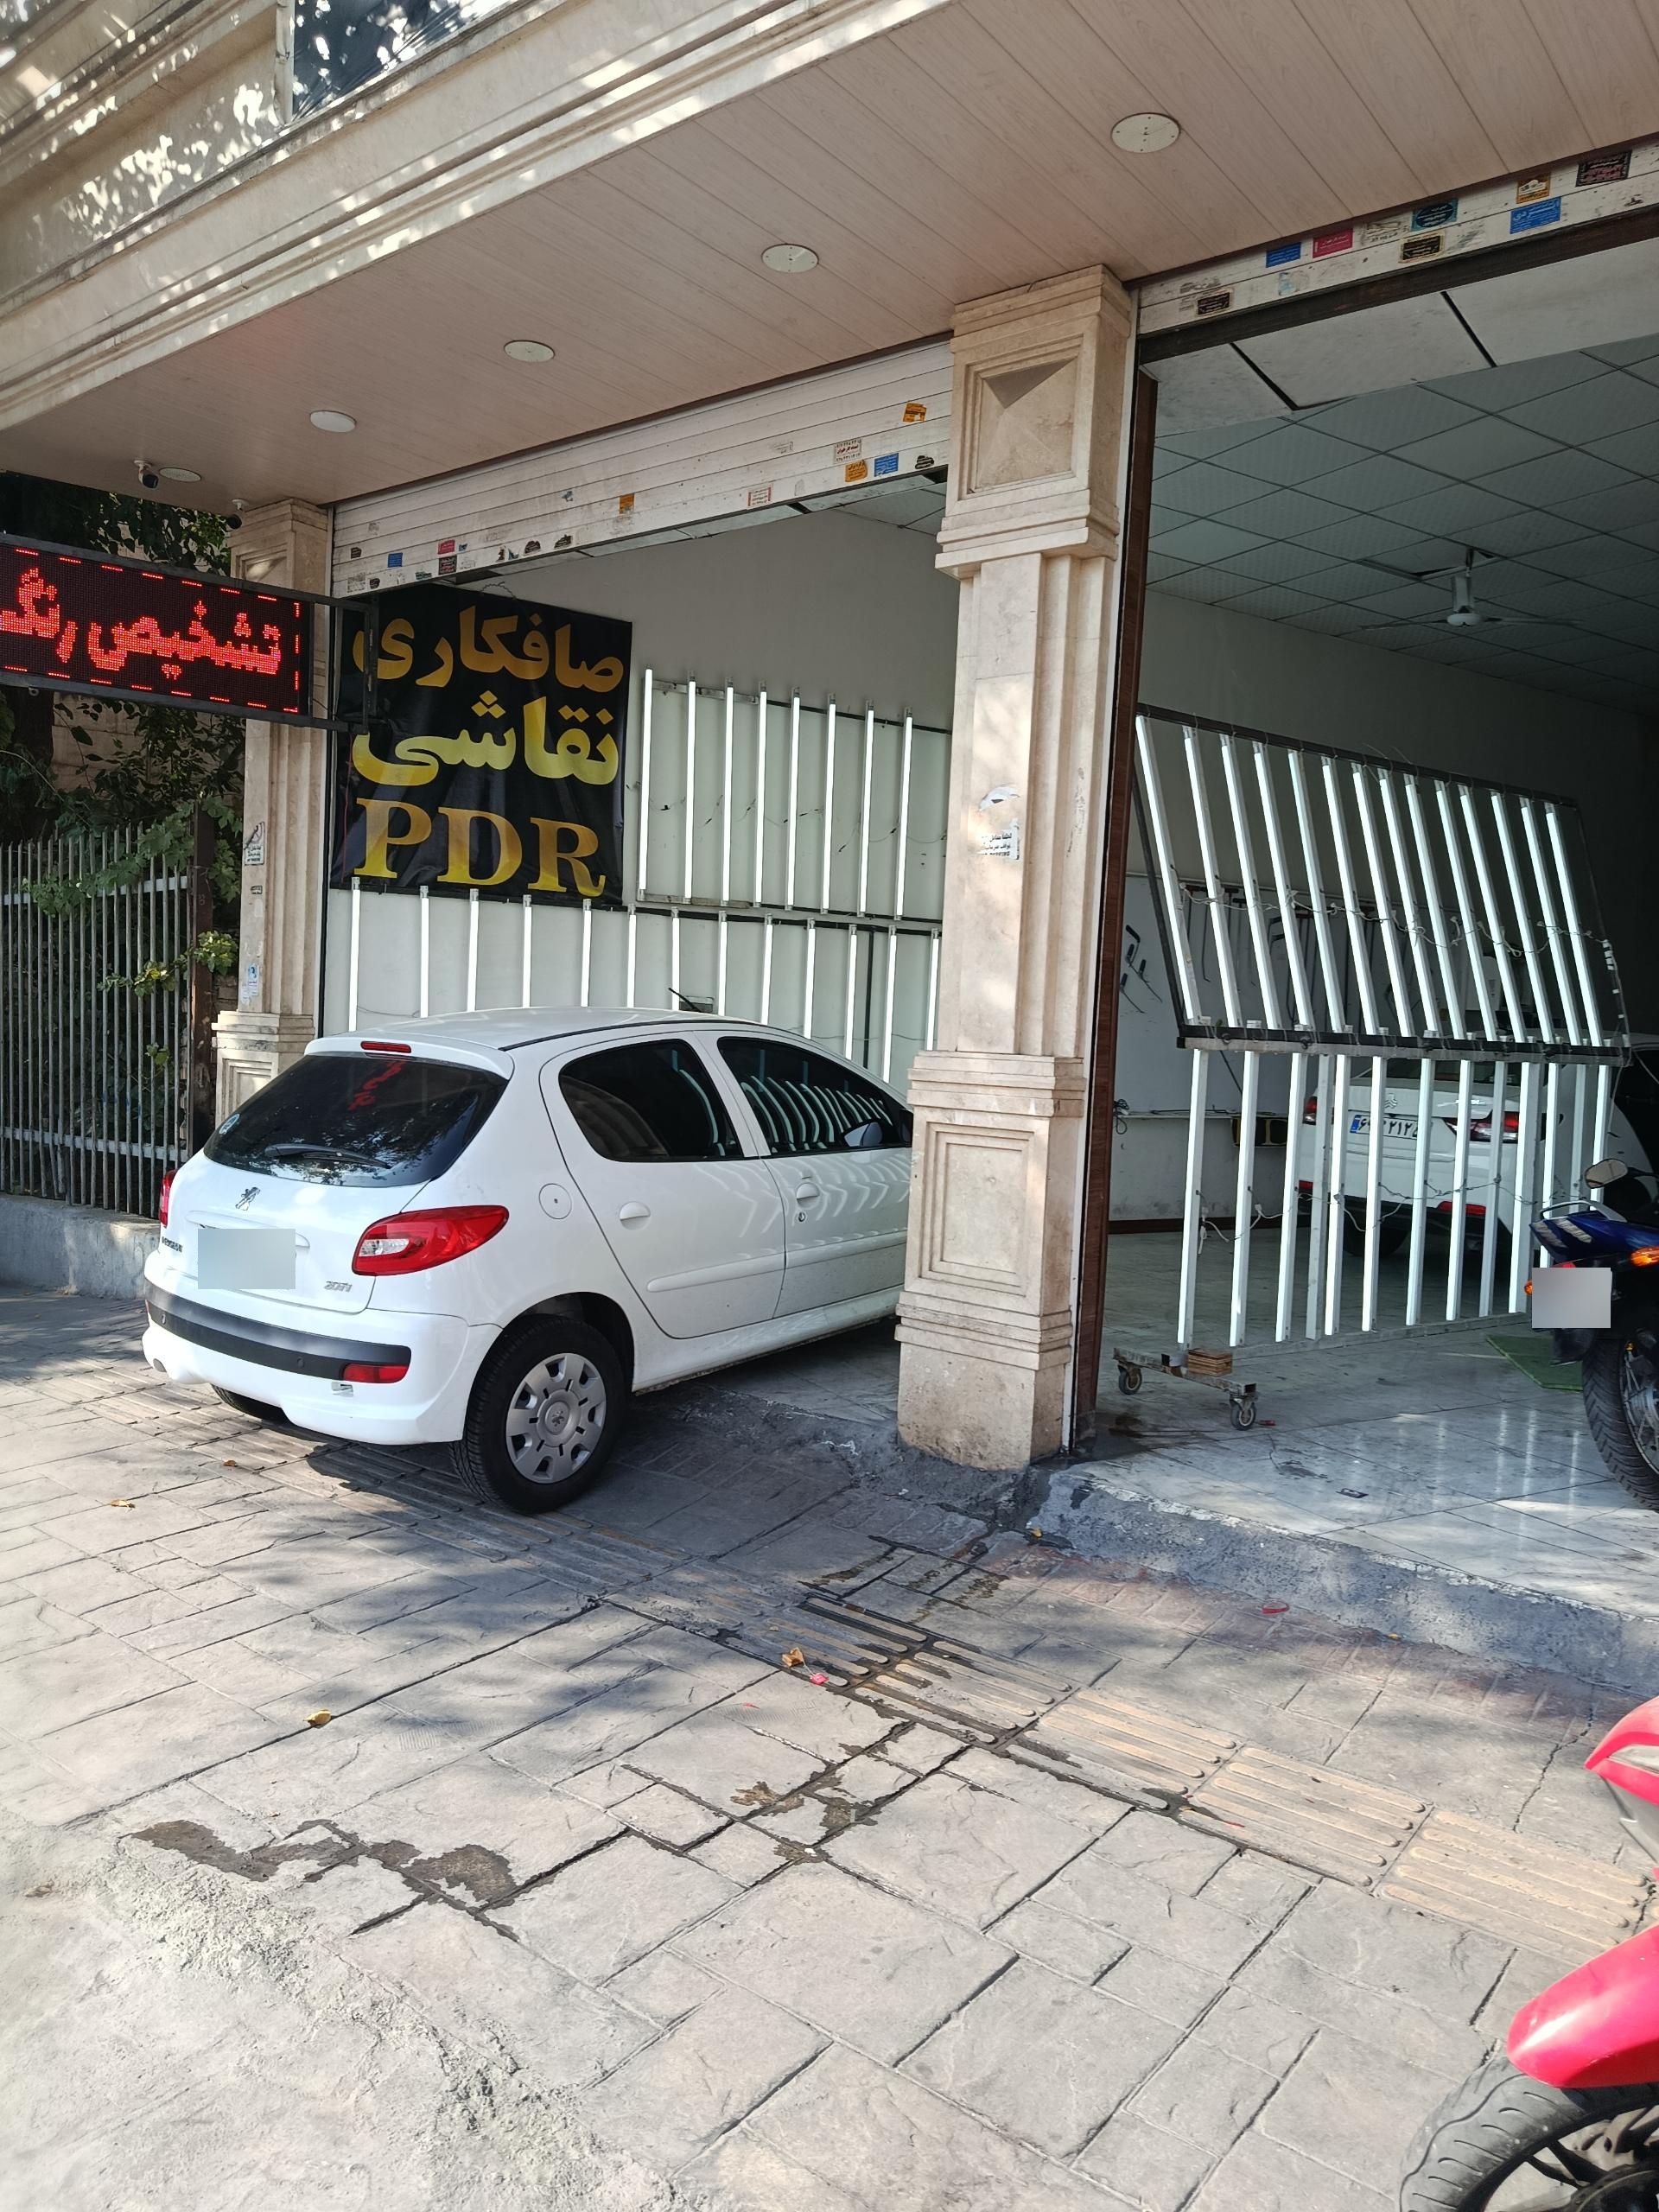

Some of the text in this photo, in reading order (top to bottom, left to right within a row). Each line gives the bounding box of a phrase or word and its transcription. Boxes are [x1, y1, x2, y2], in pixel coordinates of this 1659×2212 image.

[87, 599, 282, 680] تشخیص
[353, 605, 624, 693] صافکاری
[352, 690, 620, 786] نقاشی
[353, 797, 607, 898] PDR
